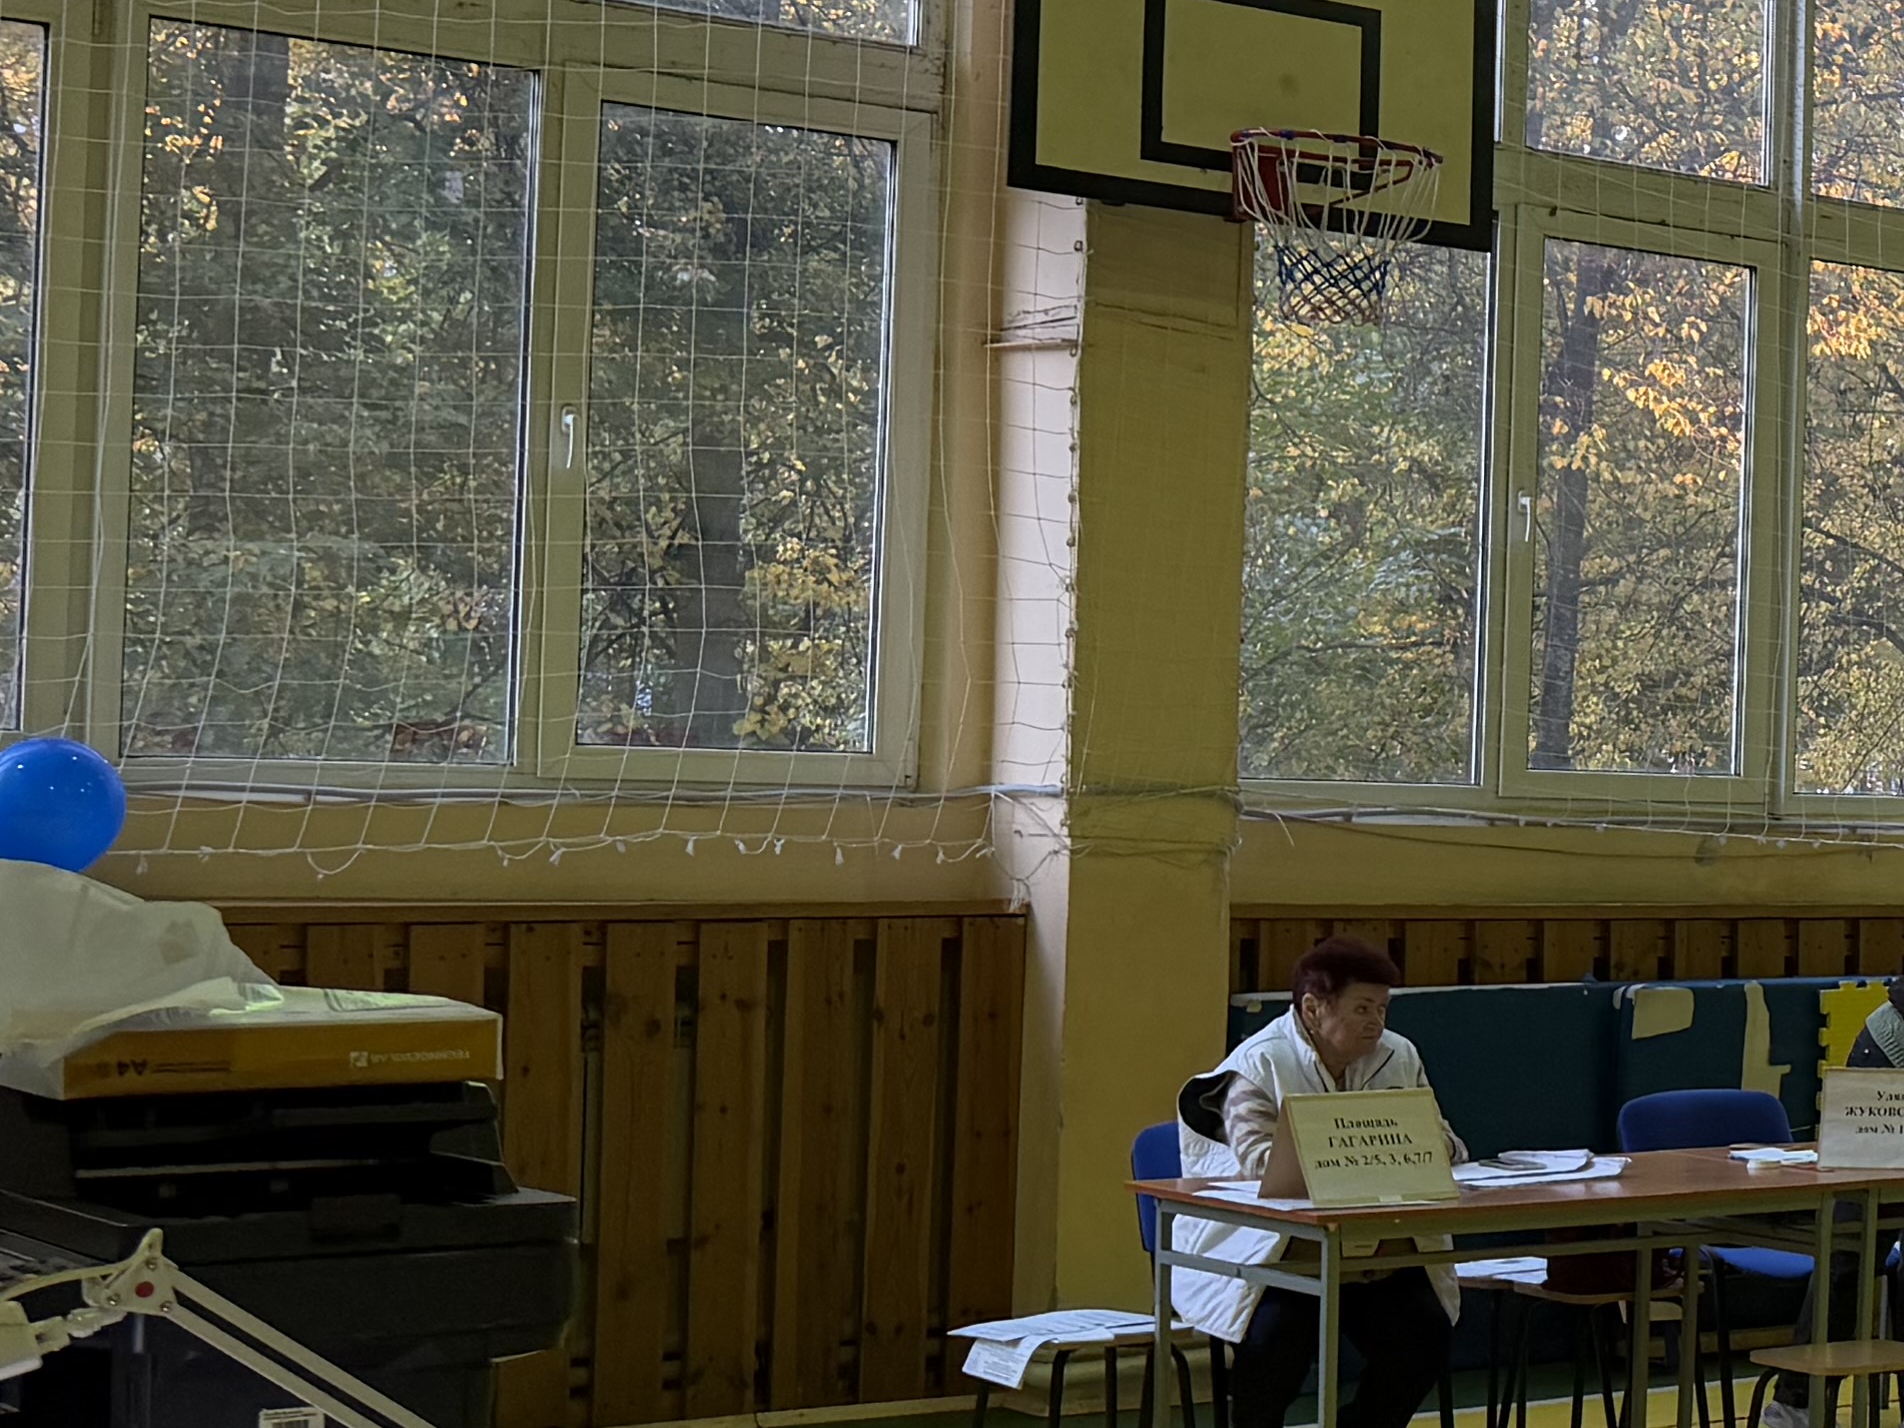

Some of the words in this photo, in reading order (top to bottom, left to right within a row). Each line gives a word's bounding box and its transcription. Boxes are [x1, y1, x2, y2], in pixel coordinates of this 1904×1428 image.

[117, 1058, 148, 1076] A4
[1334, 1117, 1398, 1130] Площадь
[1855, 1124, 1878, 1134] дом
[1880, 1123, 1895, 1134] №
[1328, 1132, 1413, 1149] ГАГАРИНА
[1314, 1159, 1340, 1170] дом
[1344, 1155, 1359, 1168] №
